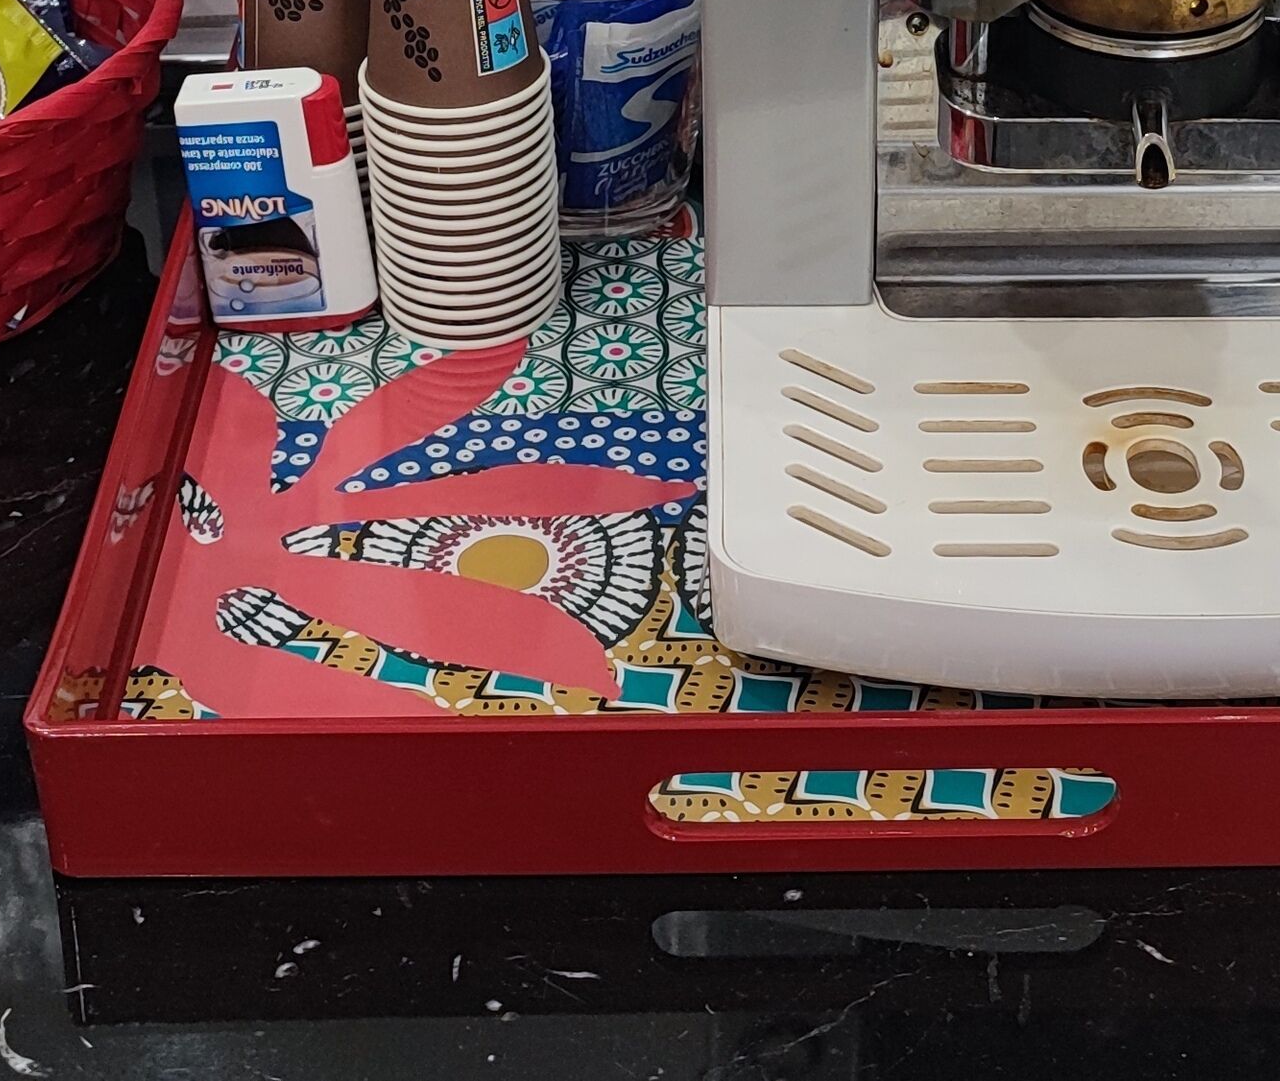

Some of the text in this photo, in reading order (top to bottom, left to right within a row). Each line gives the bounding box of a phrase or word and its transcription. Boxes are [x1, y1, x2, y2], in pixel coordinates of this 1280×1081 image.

[236, 134, 265, 145] senza
[202, 147, 216, 159] da
[218, 147, 279, 159] Edulcorante
[188, 160, 242, 172] compresse
[201, 196, 287, 220] LOVING
[232, 263, 305, 277] Dolcificante
